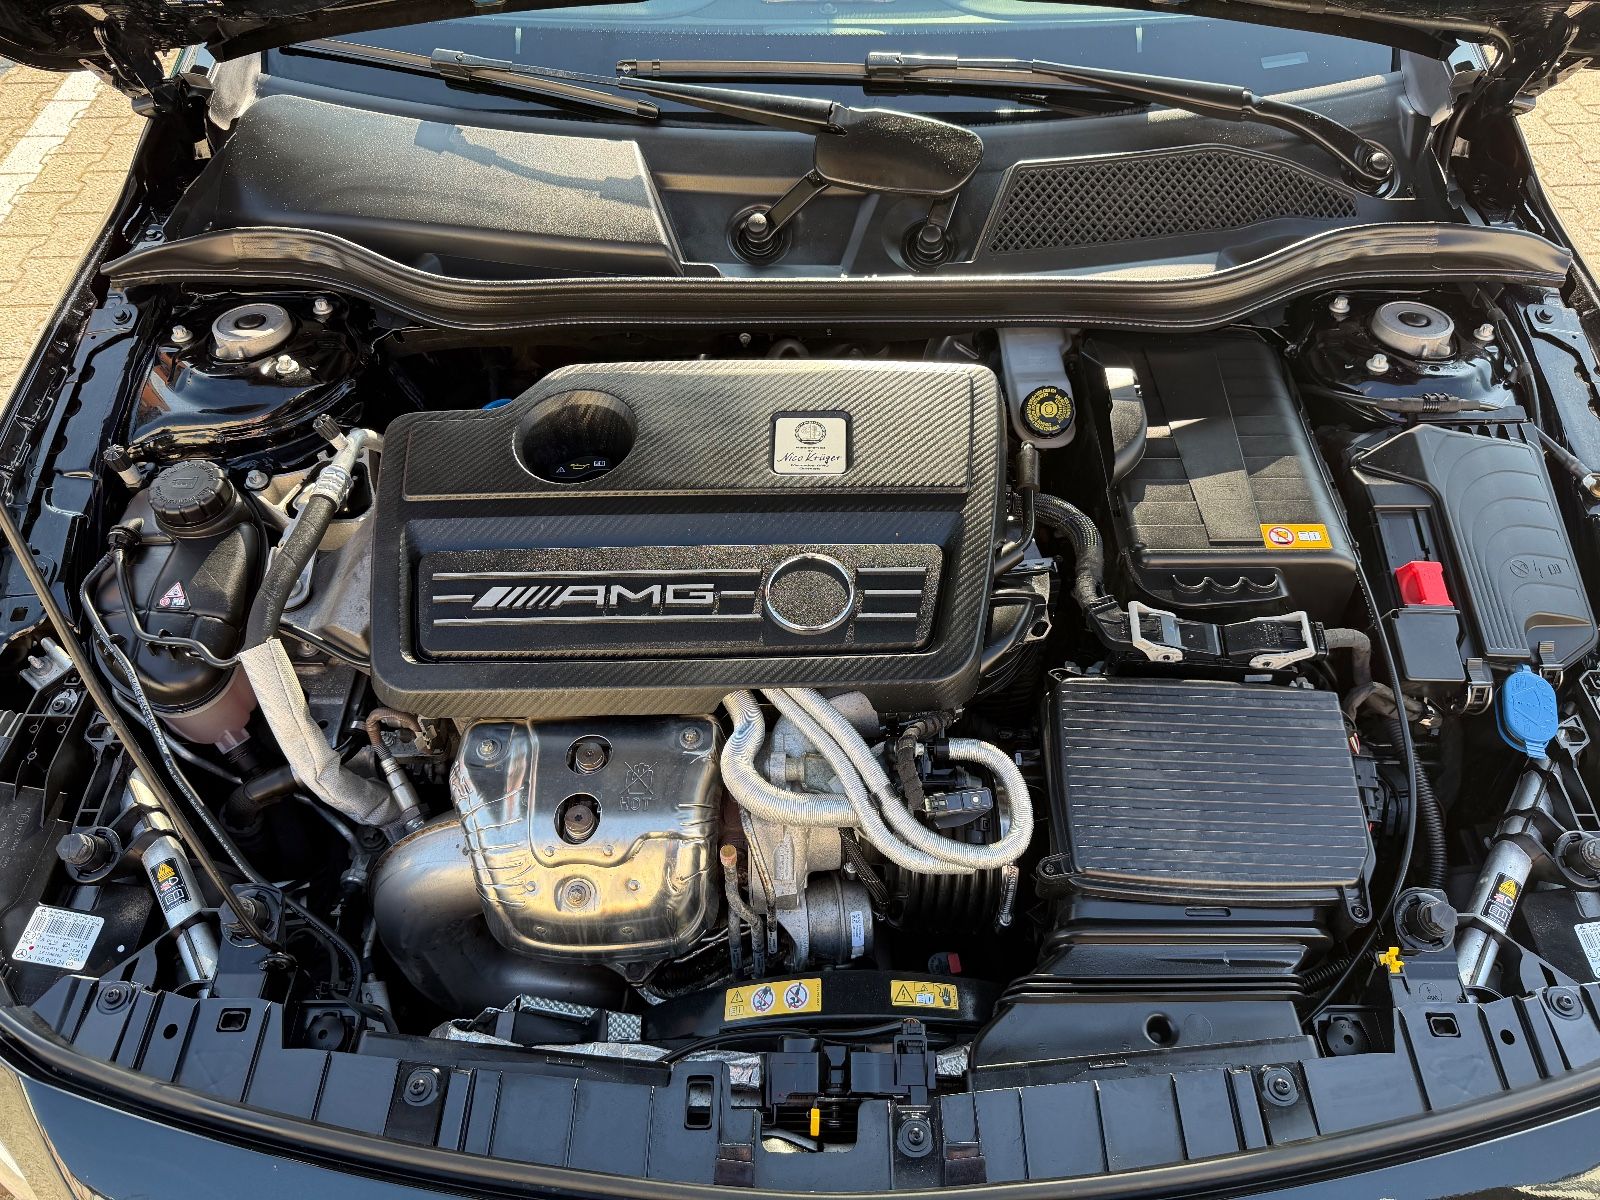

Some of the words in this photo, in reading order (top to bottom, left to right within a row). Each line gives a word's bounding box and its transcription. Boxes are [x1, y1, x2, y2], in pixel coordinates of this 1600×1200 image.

[776, 451, 804, 463] Nico
[805, 452, 841, 465] Krüger
[549, 584, 715, 609] AMG
